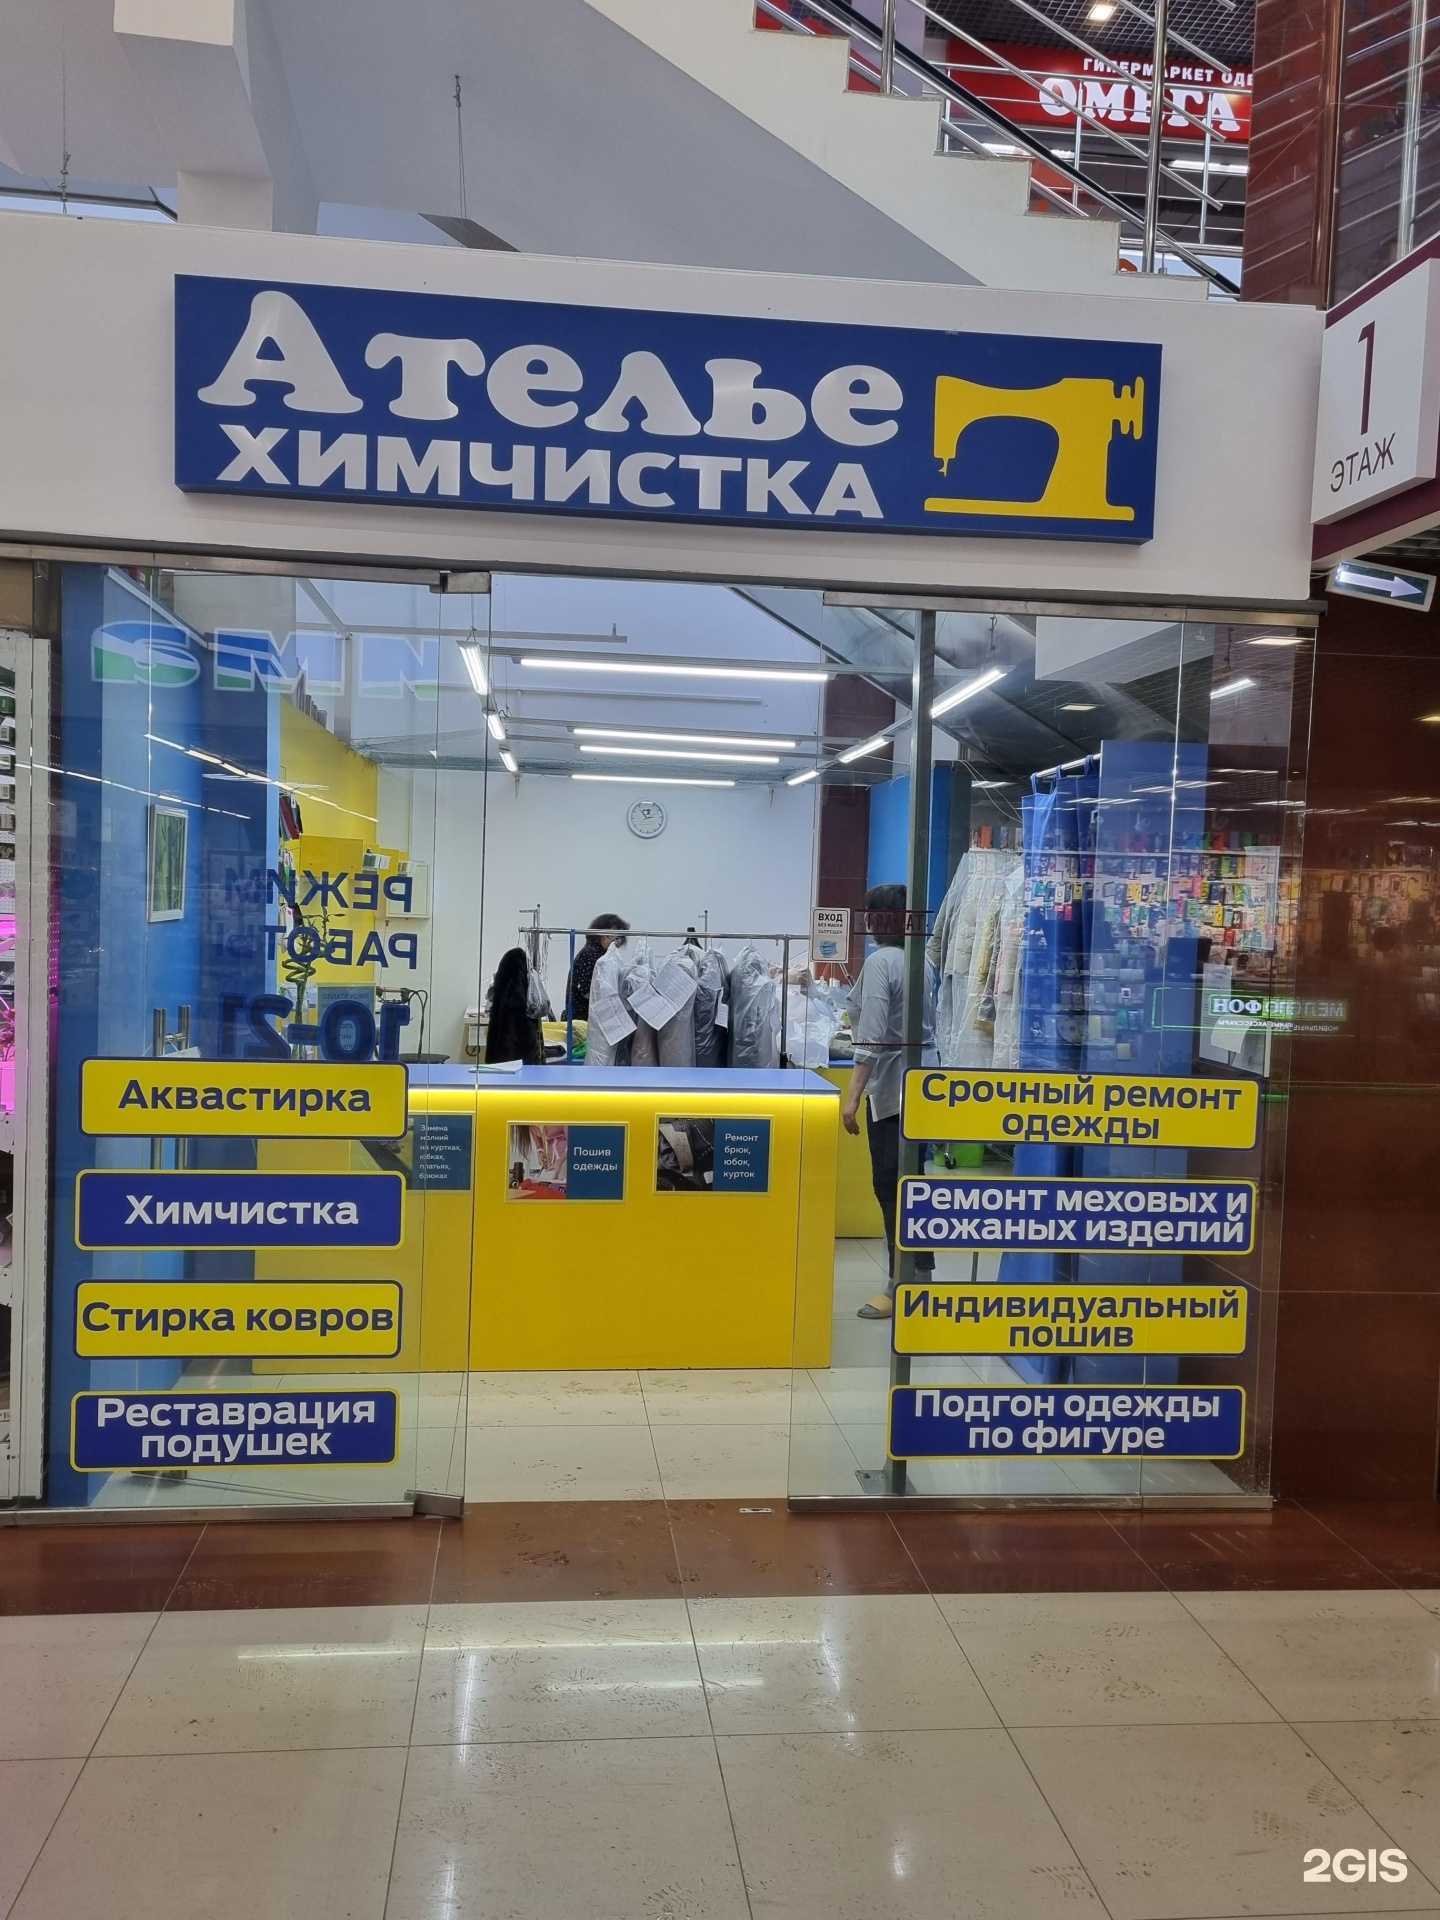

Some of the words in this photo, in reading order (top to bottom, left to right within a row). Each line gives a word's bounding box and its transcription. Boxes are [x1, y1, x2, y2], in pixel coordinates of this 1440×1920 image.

[1083, 58, 1214, 82] ГИПЕРМРКЕТ
[1039, 77, 1241, 132] ОМЕГА
[196, 289, 904, 447] Ателье
[1356, 319, 1376, 436] 1
[216, 422, 884, 519] ХИМЧИСТКА
[1329, 432, 1396, 493] ЭТАЖ
[818, 913, 843, 922] ВХОД
[118, 1079, 371, 1117] Аквастирка
[921, 1073, 1094, 1107] Срочный
[1103, 1085, 1242, 1111] ремонт
[724, 1132, 759, 1143] Ремонт
[1002, 1113, 1159, 1143] одежды
[573, 1146, 611, 1158] Пошив
[723, 1145, 751, 1155] брюк,
[723, 1157, 751, 1167] юбок,
[572, 1161, 618, 1173] одежды
[722, 1170, 755, 1181] курток
[124, 1194, 359, 1225] Химчистка
[906, 1182, 1047, 1211] Ремонт
[1056, 1189, 1215, 1213] меховых
[1226, 1193, 1247, 1213] и
[907, 1216, 1077, 1241] кожаных
[1086, 1213, 1244, 1247] изделий
[82, 1302, 235, 1337] Стирка
[246, 1308, 393, 1337] ковров
[904, 1289, 1239, 1323] Индивидуальный
[1009, 1325, 1133, 1347] пошив
[97, 1398, 375, 1430] Реставрация
[915, 1390, 1054, 1422] Подгон
[1064, 1395, 1219, 1423] одежды
[141, 1431, 332, 1463] подушек
[968, 1426, 1014, 1448] по
[1022, 1420, 1165, 1453] фигуре
